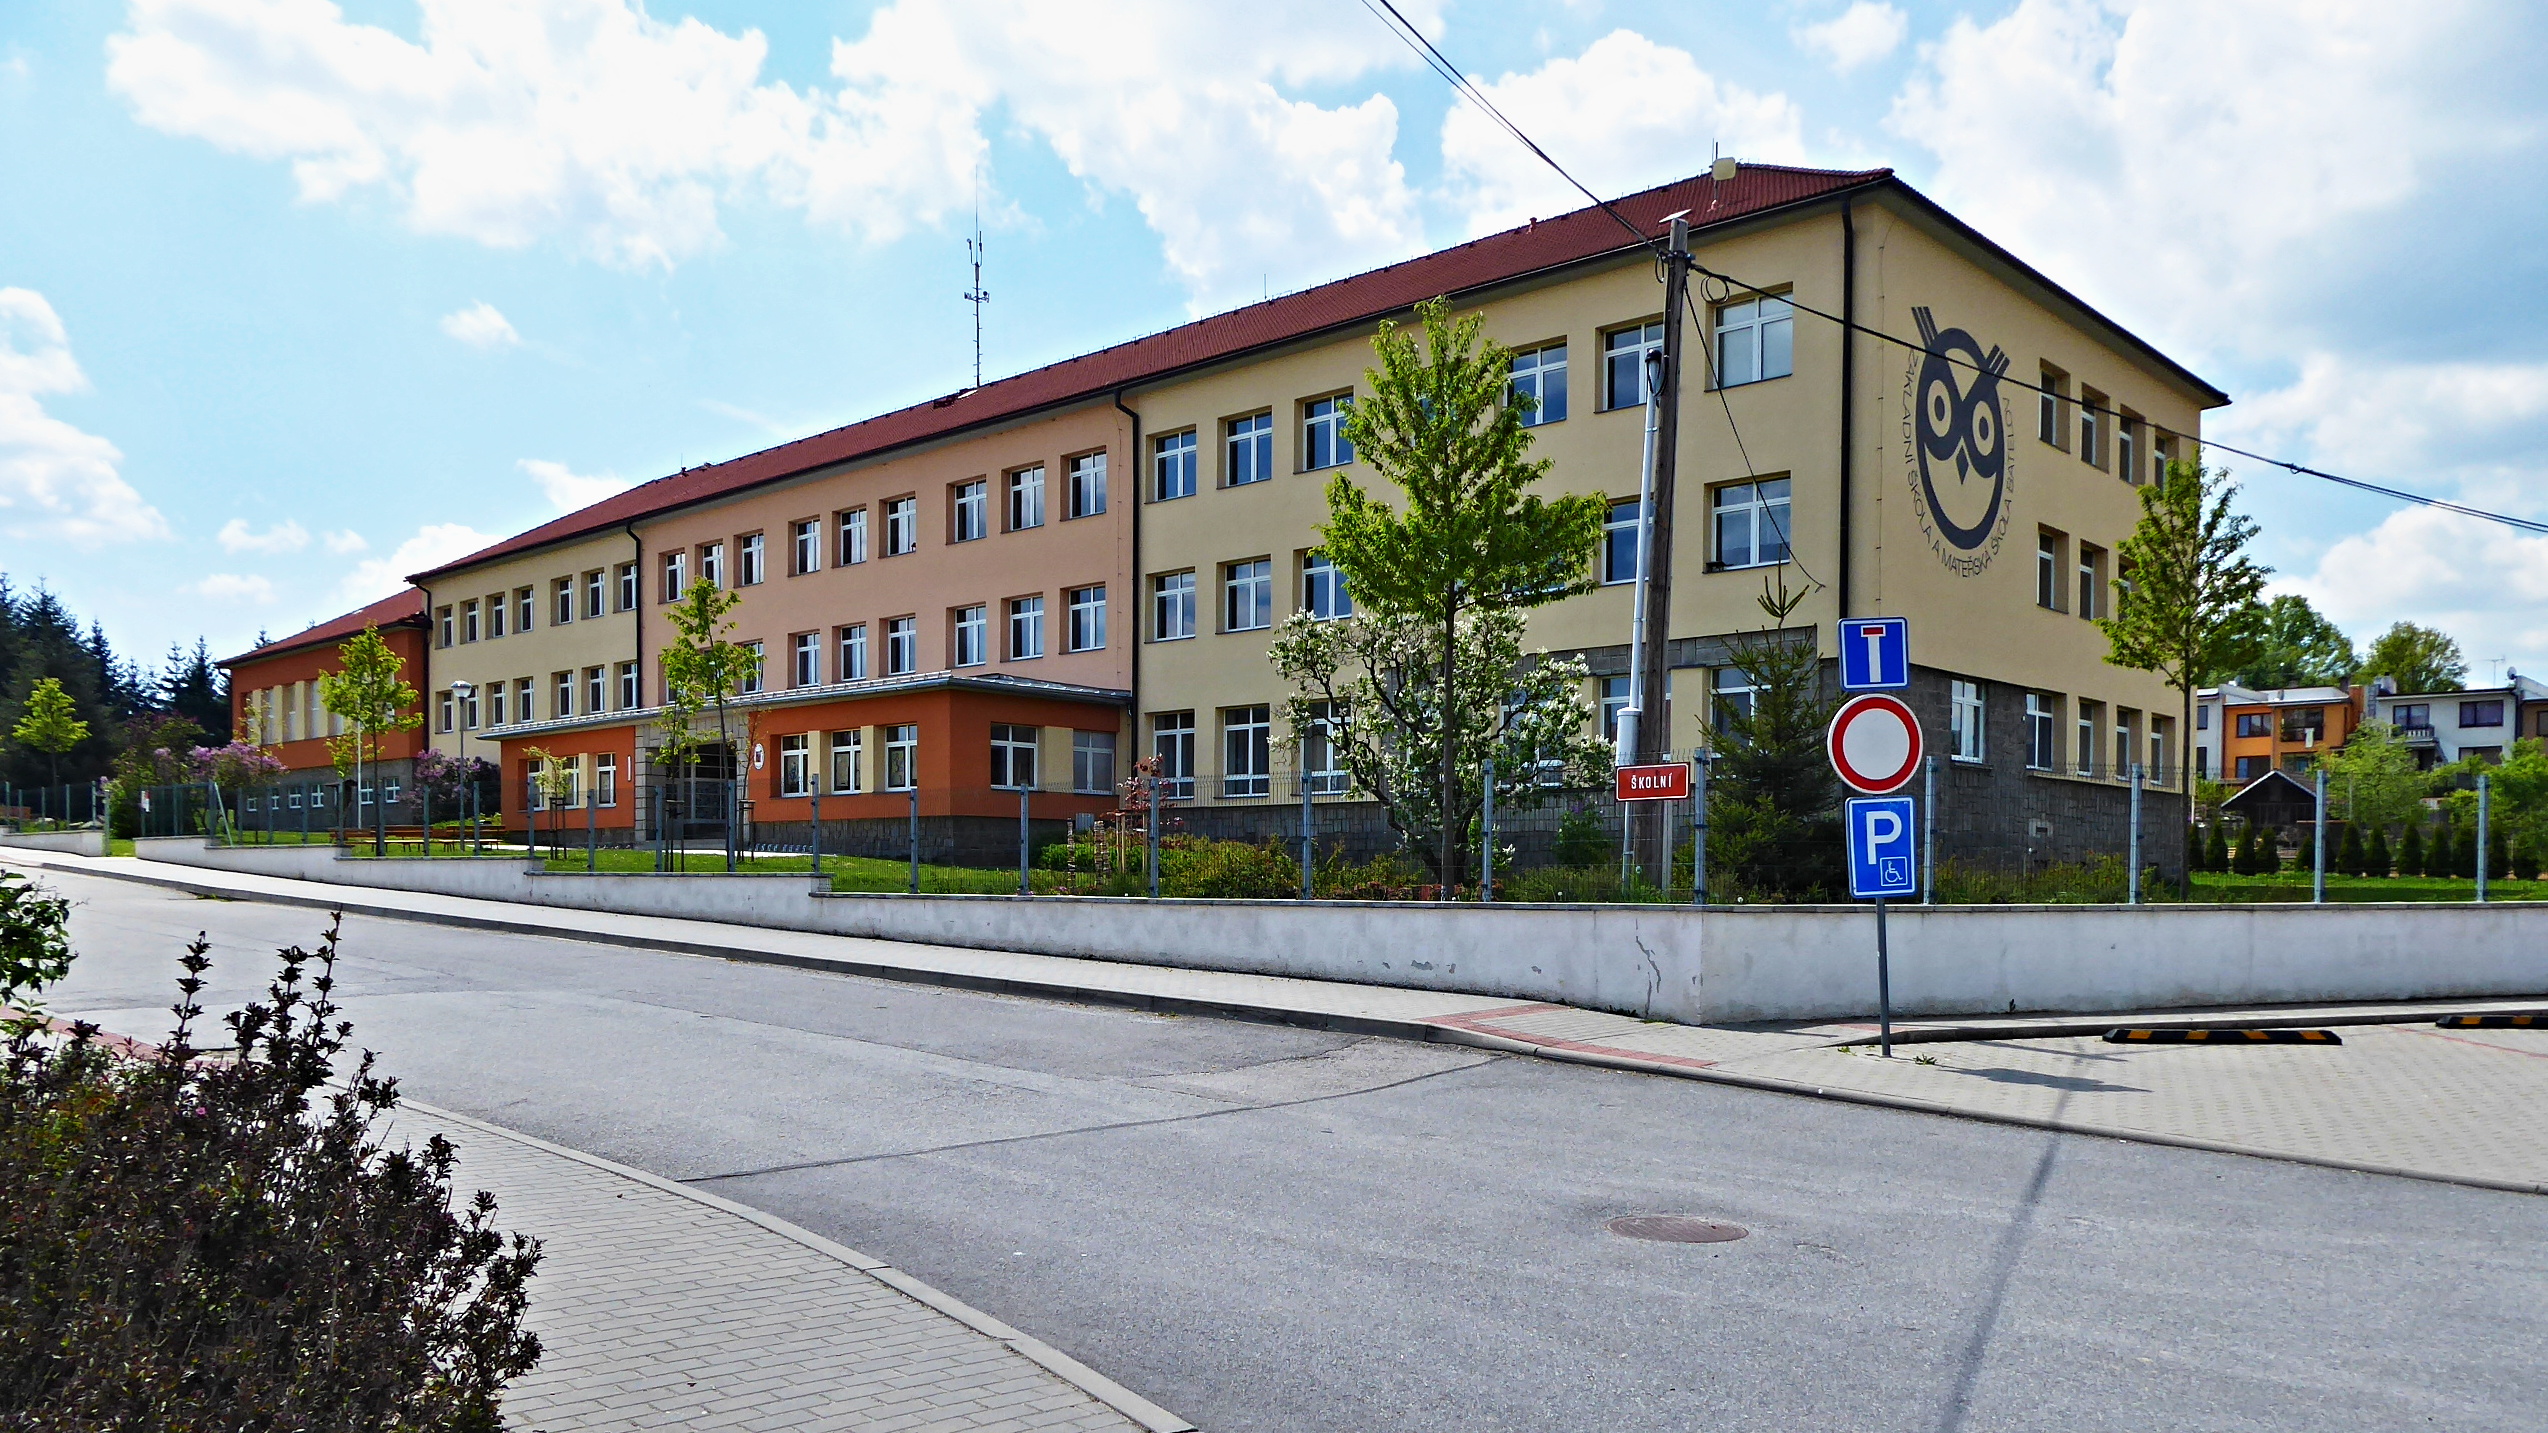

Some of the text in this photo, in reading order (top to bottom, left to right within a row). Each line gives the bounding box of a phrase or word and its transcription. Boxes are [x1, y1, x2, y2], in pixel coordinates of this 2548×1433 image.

[1907, 469, 1932, 544] ŠKOLA
[1931, 539, 1940, 559] A
[1631, 772, 1673, 790] ŠKOLNÍ
[1866, 810, 1903, 865] P
